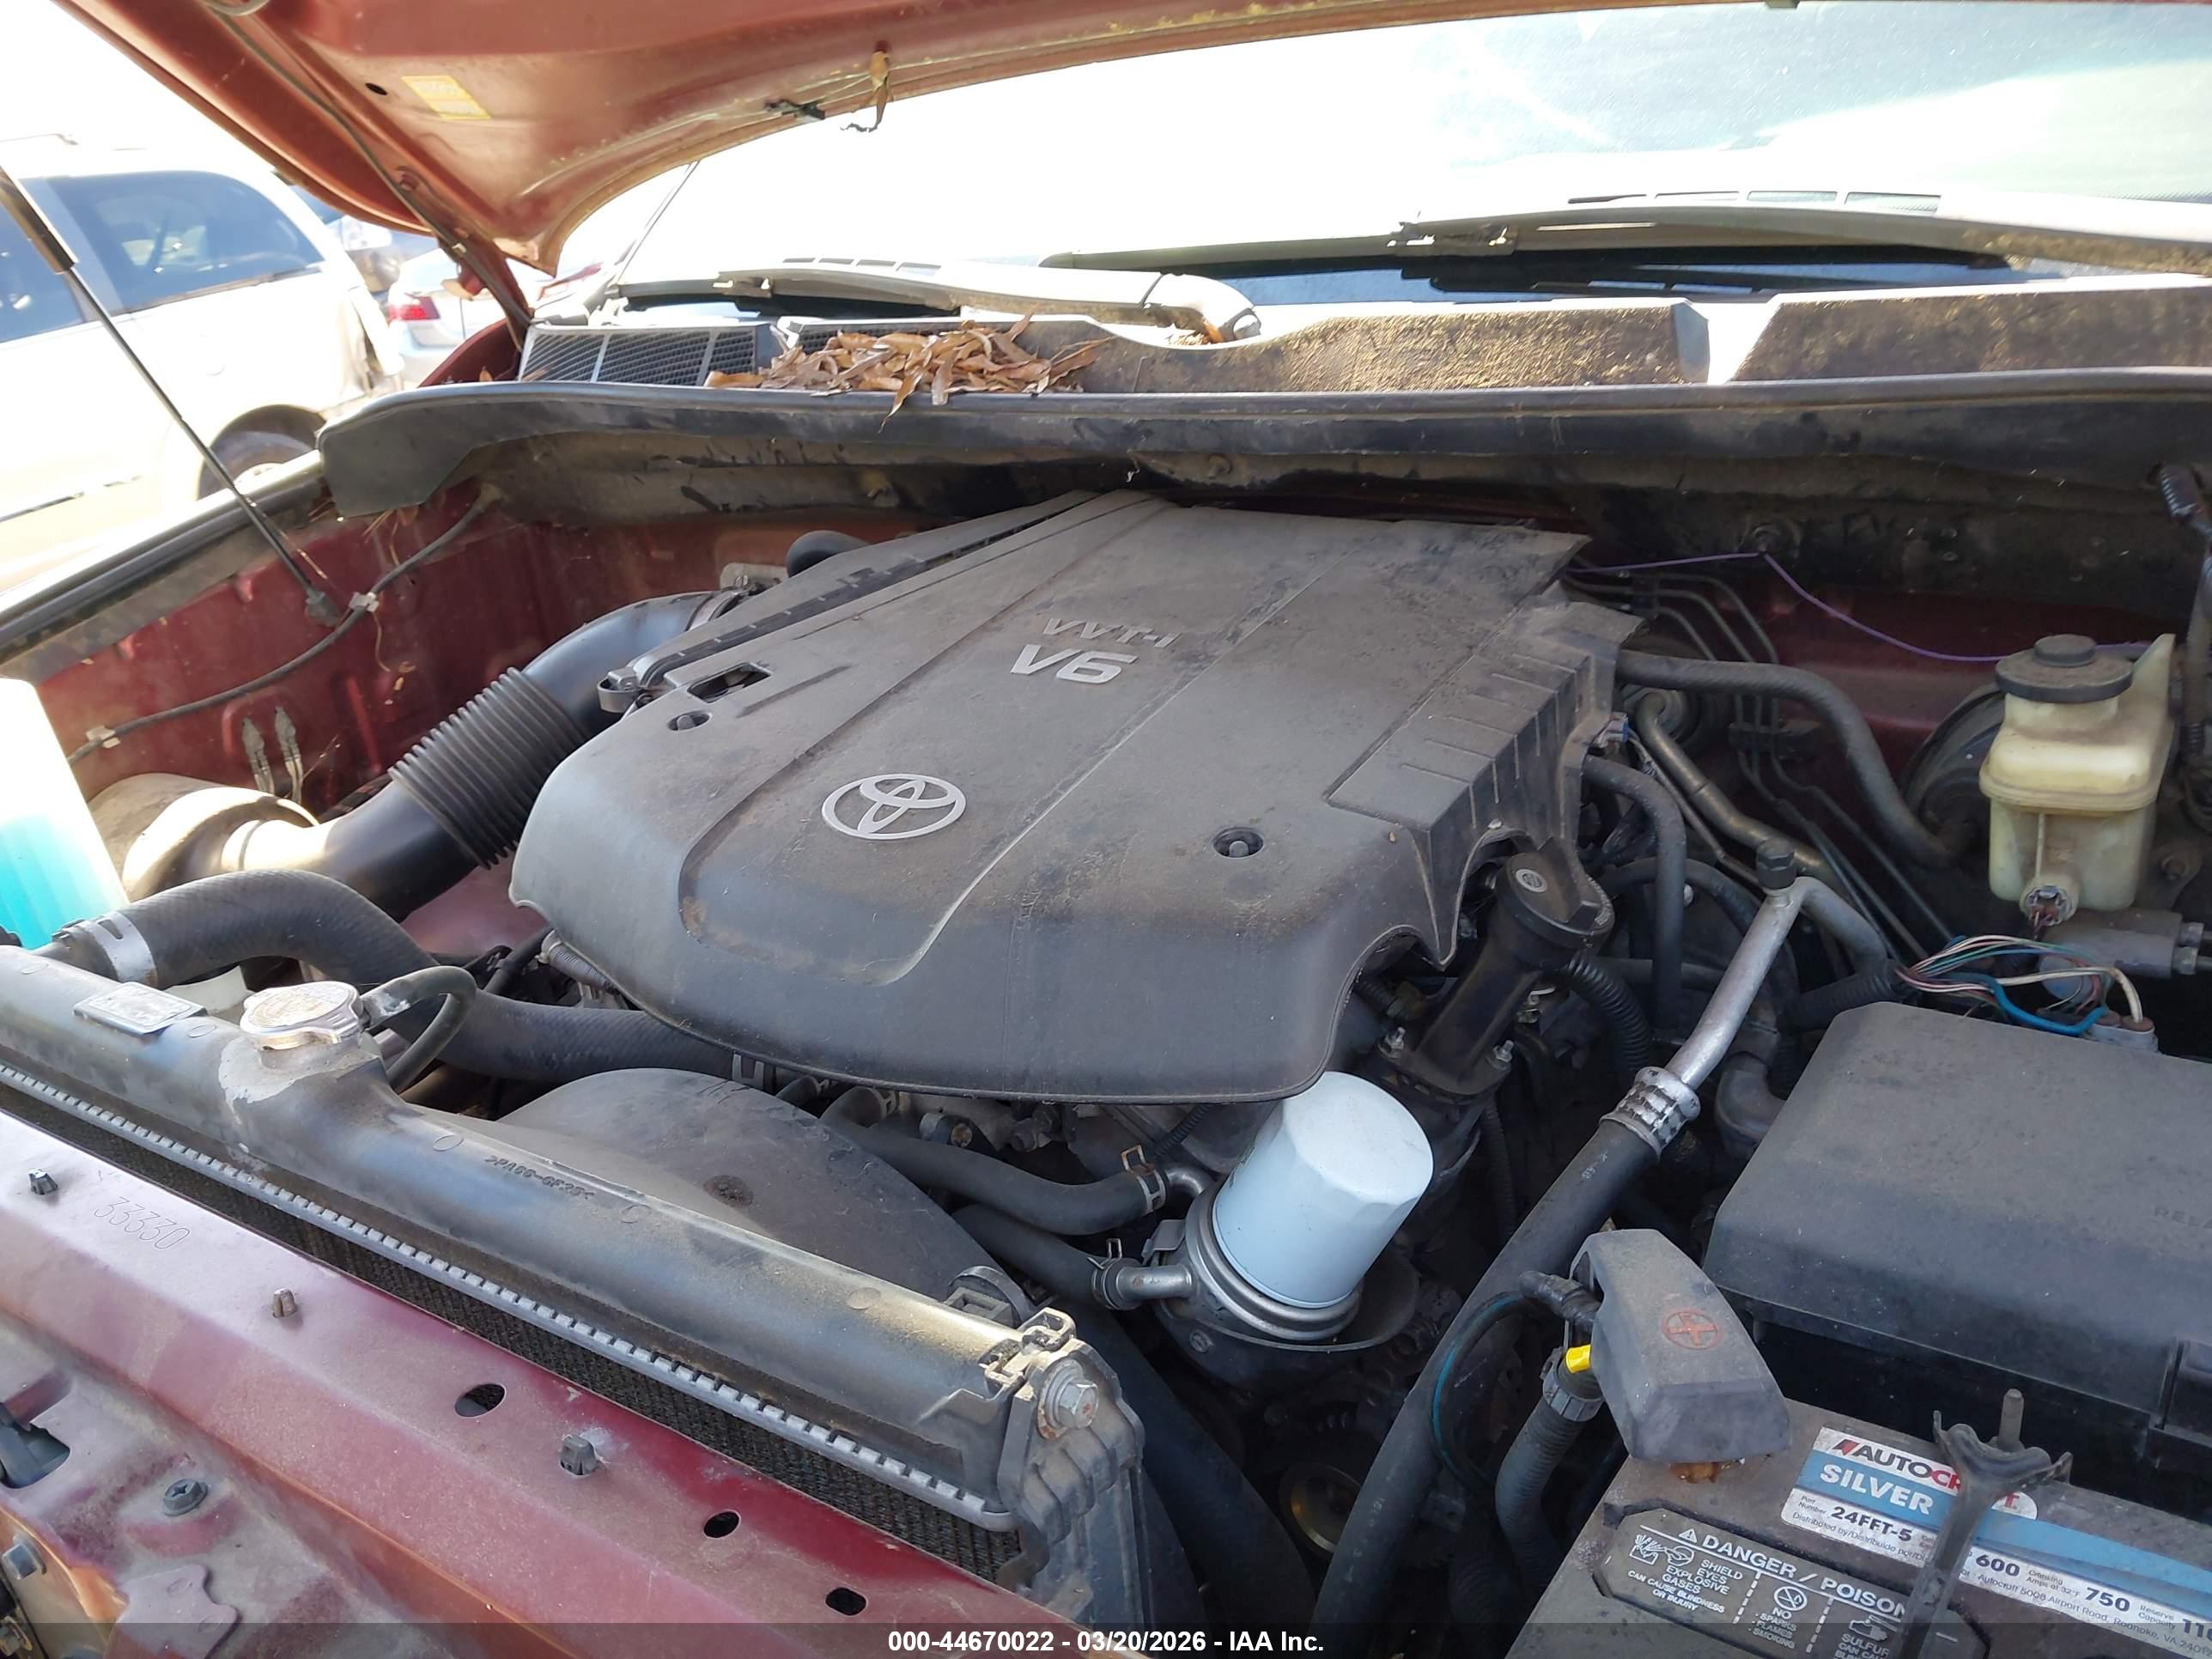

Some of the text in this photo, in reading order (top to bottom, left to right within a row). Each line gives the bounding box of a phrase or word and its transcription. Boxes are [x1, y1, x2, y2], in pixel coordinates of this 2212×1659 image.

[1010, 644, 1139, 684] V6
[94, 1196, 191, 1249] 33330
[1801, 1496, 1816, 1504] Part
[1820, 1464, 1934, 1515] SILVER
[1798, 1502, 1826, 1515] Number
[1831, 1506, 1912, 1541] 24FFT-5
[1702, 1534, 1797, 1578] DANGER
[1976, 1554, 2021, 1577] 600
[1666, 1565, 1730, 1595] EXPLOSIVE
[1696, 1568, 1727, 1584] EYES
[1701, 1559, 1743, 1580] SHIELD
[1792, 1512, 1837, 1532] Distributed
[2020, 1587, 2046, 1601] 5008
[2047, 1592, 2081, 1612] Airport
[2082, 1607, 2110, 1623] Road,
[2114, 1617, 2160, 1640] Roanoke,
[2164, 1634, 2178, 1645] VA
[2027, 1570, 2063, 1586] Cranking
[1627, 1571, 1725, 1613] CAN CAUSE BLINDNESS
[1662, 1573, 1700, 1594] GASES
[2026, 1577, 2049, 1588] Amps
[1652, 1589, 1699, 1611] OR INJURY
[2085, 1587, 2130, 1612] 750
[1759, 1613, 1797, 1632] SPARKS
[1772, 1607, 1792, 1620] NO
[2138, 1613, 2176, 1630] Capacity
[2140, 1604, 2174, 1621] Reserve
[1753, 1628, 1796, 1650] SMOKING
[1756, 1620, 1793, 1638] FLAMES
[1838, 1642, 1860, 1656] CAN
